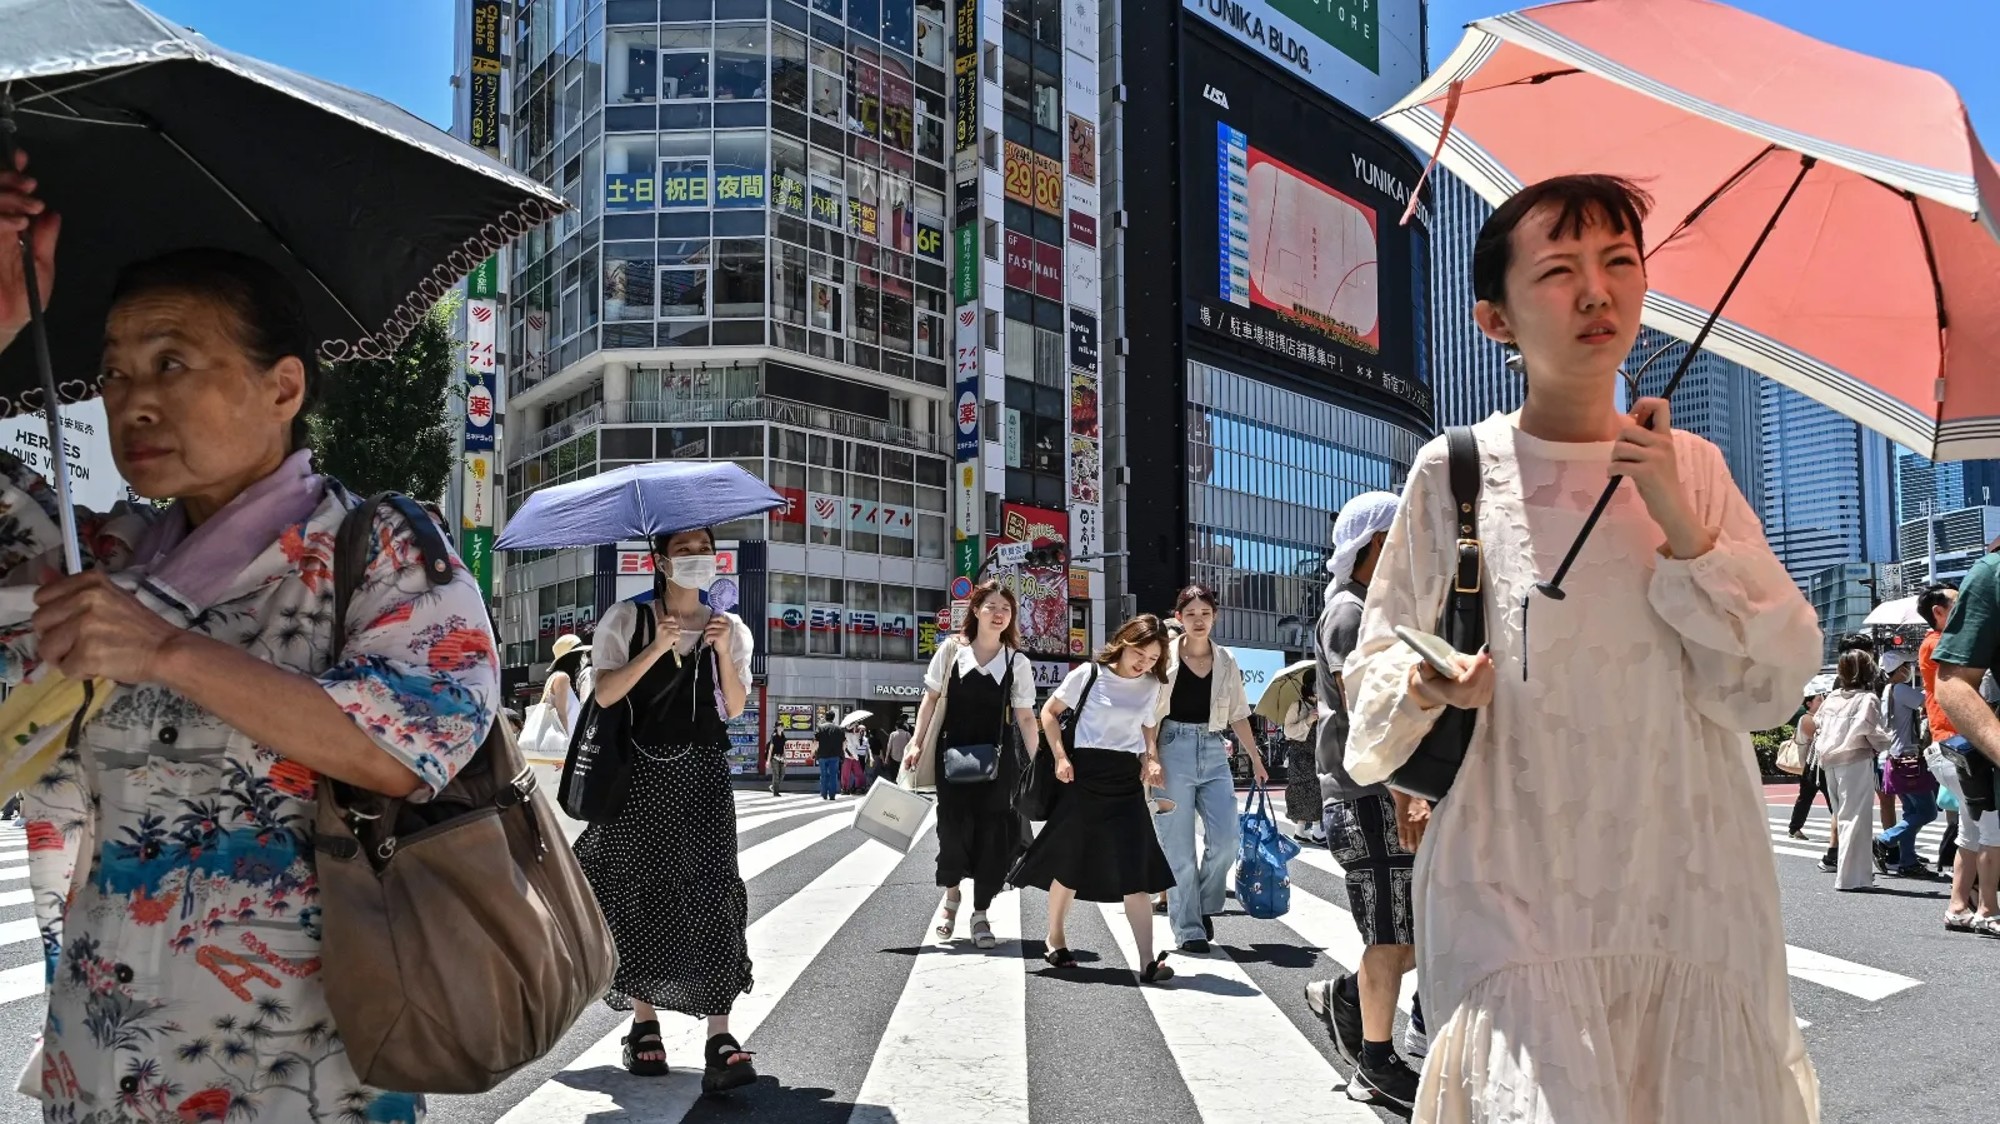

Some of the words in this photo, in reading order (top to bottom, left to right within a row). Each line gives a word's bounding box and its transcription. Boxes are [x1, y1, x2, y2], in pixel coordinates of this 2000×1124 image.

[664, 177, 708, 201] 祝日
[717, 174, 764, 200] 夜間
[1351, 152, 1406, 205] YUNIKA
[917, 228, 941, 253] 6F
[1007, 253, 1060, 280] FASTNAIL
[469, 395, 491, 418] 薬
[959, 402, 976, 425] 薬
[849, 503, 913, 527] アイフル
